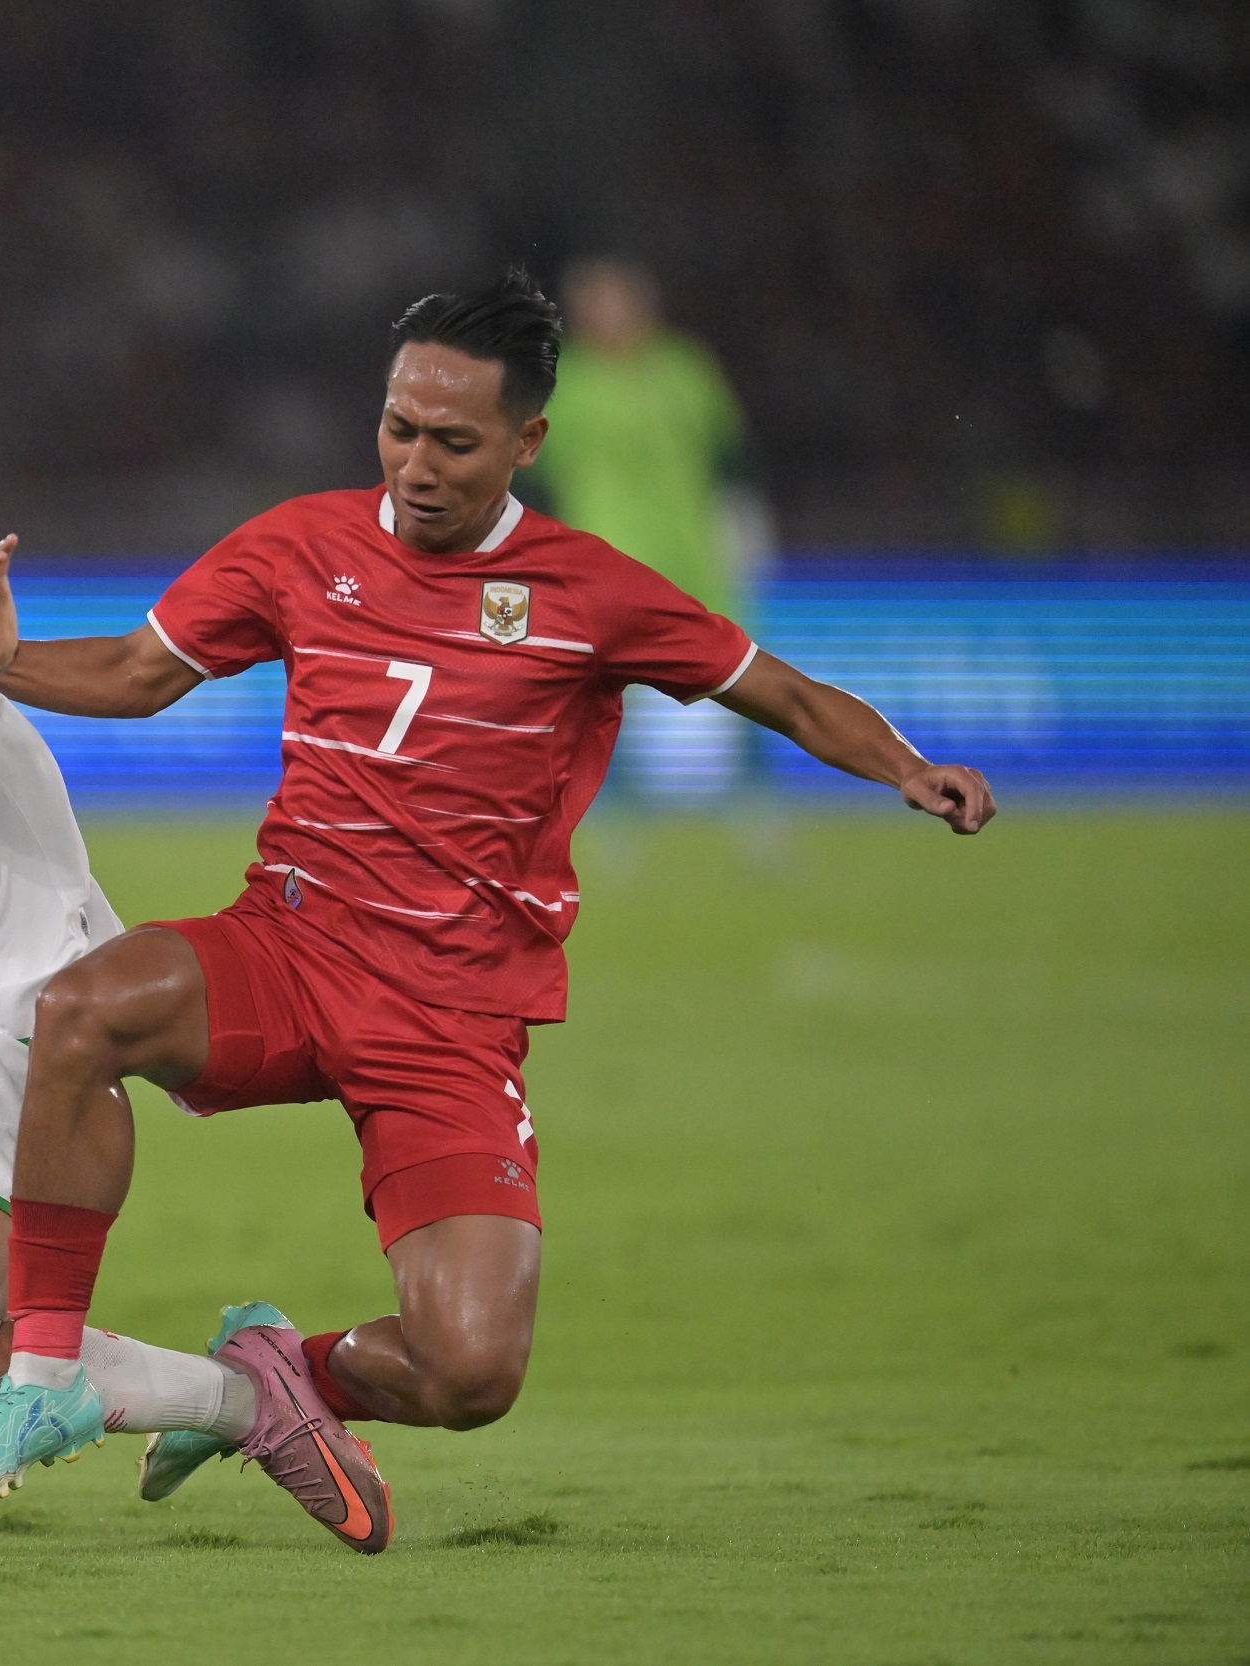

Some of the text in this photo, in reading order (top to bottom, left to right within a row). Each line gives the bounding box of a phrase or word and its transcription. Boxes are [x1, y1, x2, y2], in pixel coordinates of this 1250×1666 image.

[326, 590, 362, 607] KELME
[377, 660, 433, 755] 7
[493, 1176, 530, 1192] KELME
